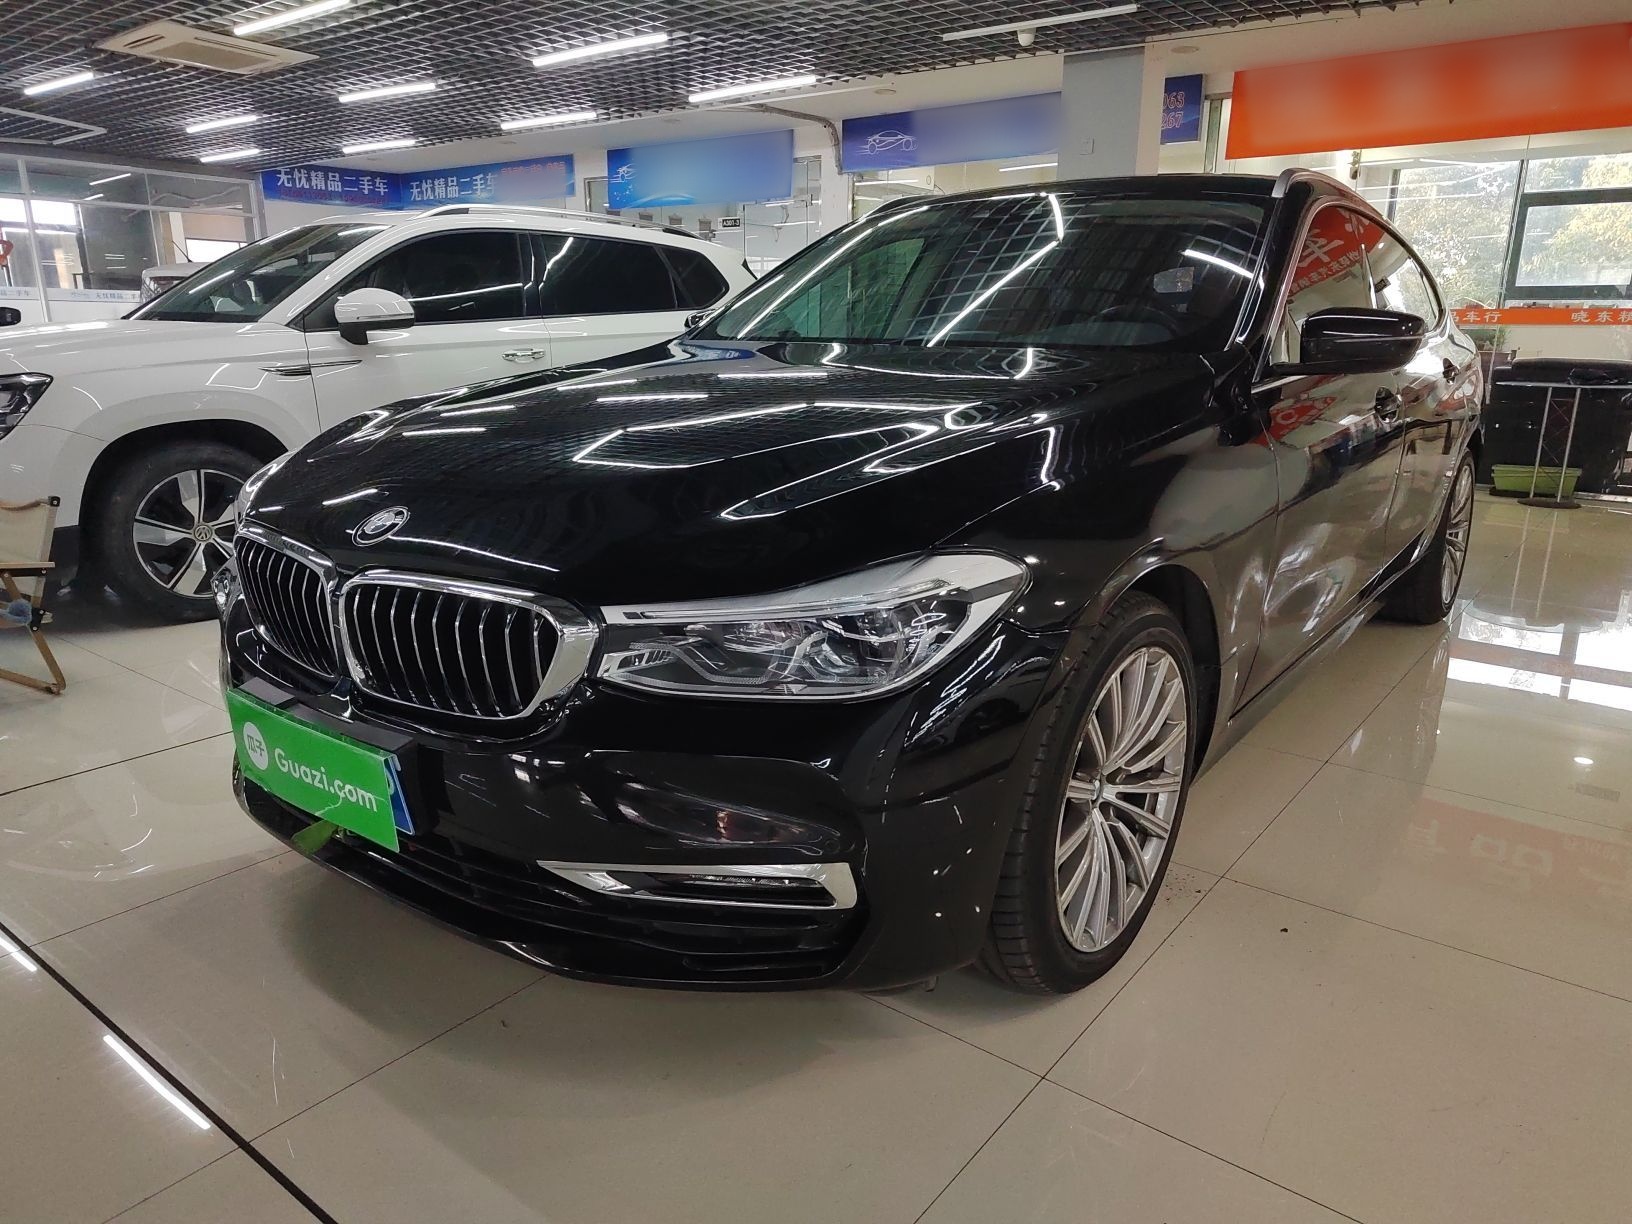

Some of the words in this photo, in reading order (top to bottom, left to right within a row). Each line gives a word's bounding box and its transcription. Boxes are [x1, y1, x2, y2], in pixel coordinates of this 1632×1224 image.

[276, 168, 389, 196] 无忧精品二手车
[247, 733, 265, 757] 瓜子
[274, 747, 379, 813] Guazi.com
